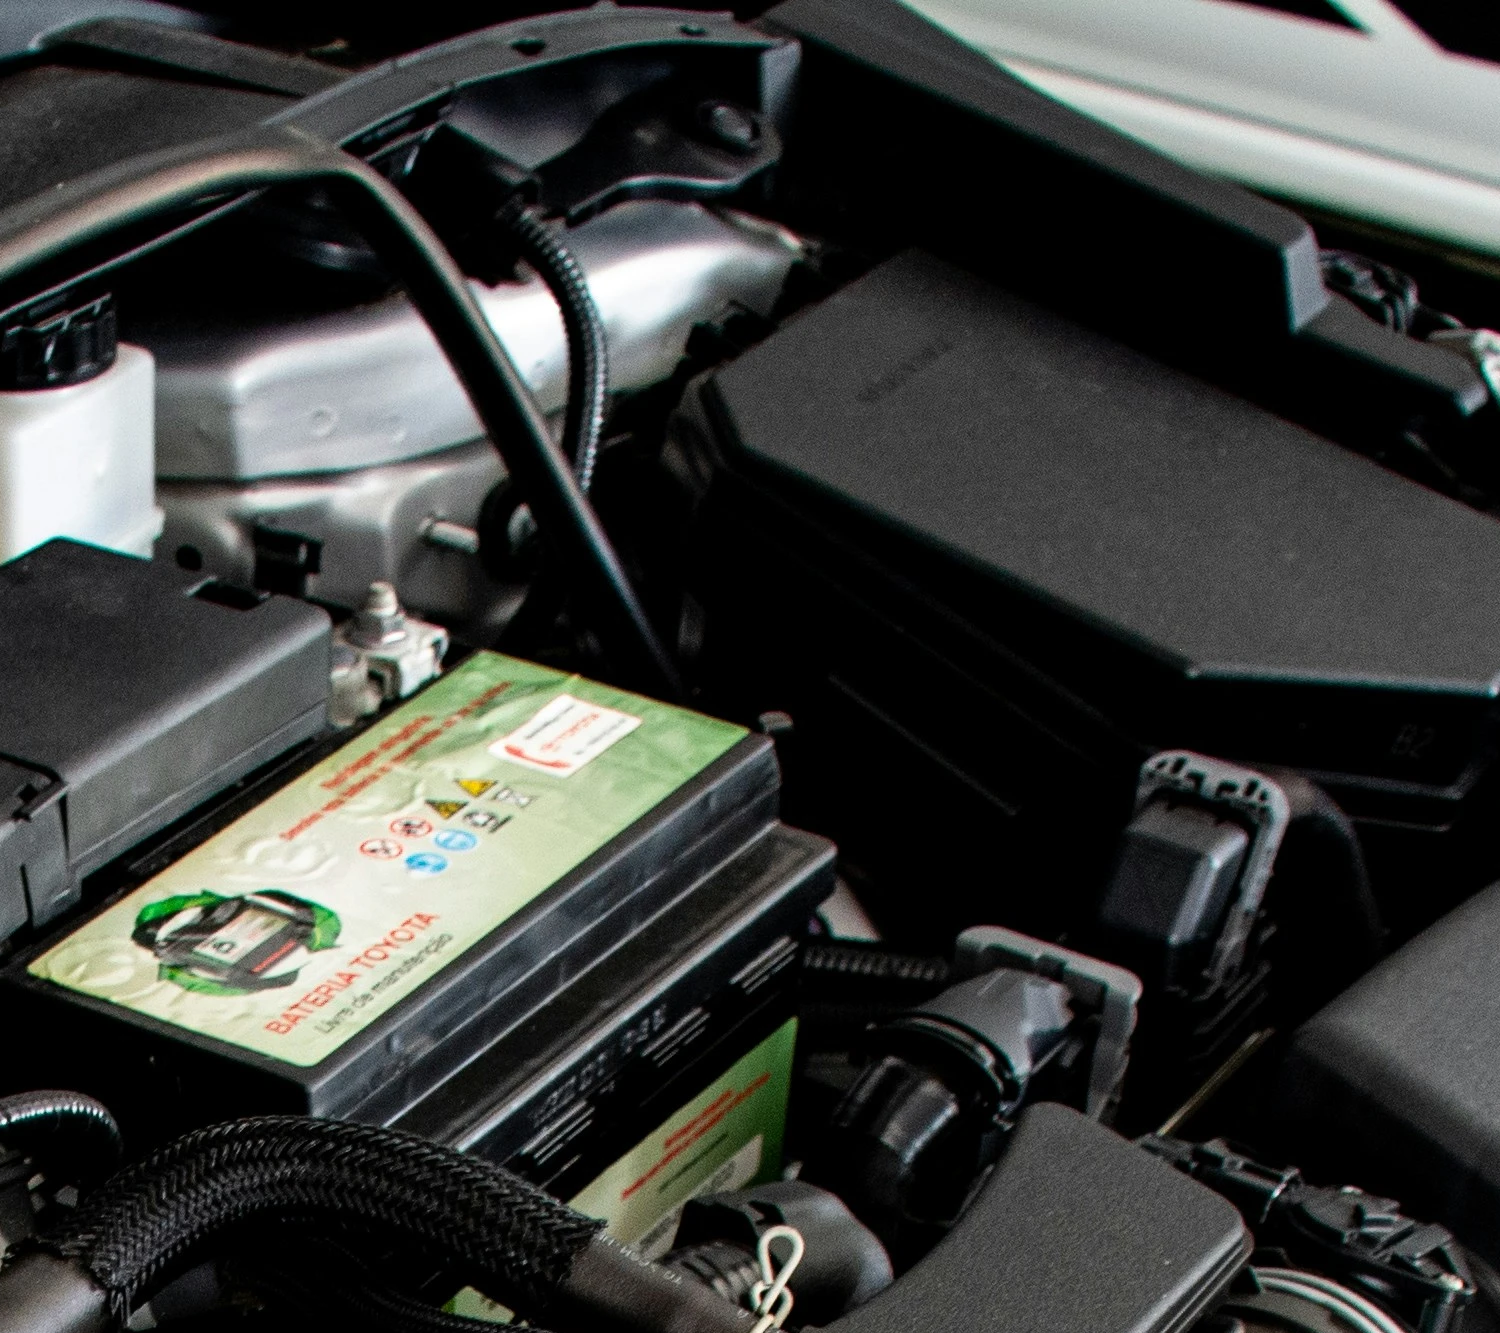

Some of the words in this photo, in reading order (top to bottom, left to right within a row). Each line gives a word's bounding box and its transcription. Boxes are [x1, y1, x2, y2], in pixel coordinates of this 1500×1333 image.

[264, 972, 362, 1035] BATERIA
[349, 912, 441, 969] TOYOTA
[314, 1007, 354, 1034] Livre
